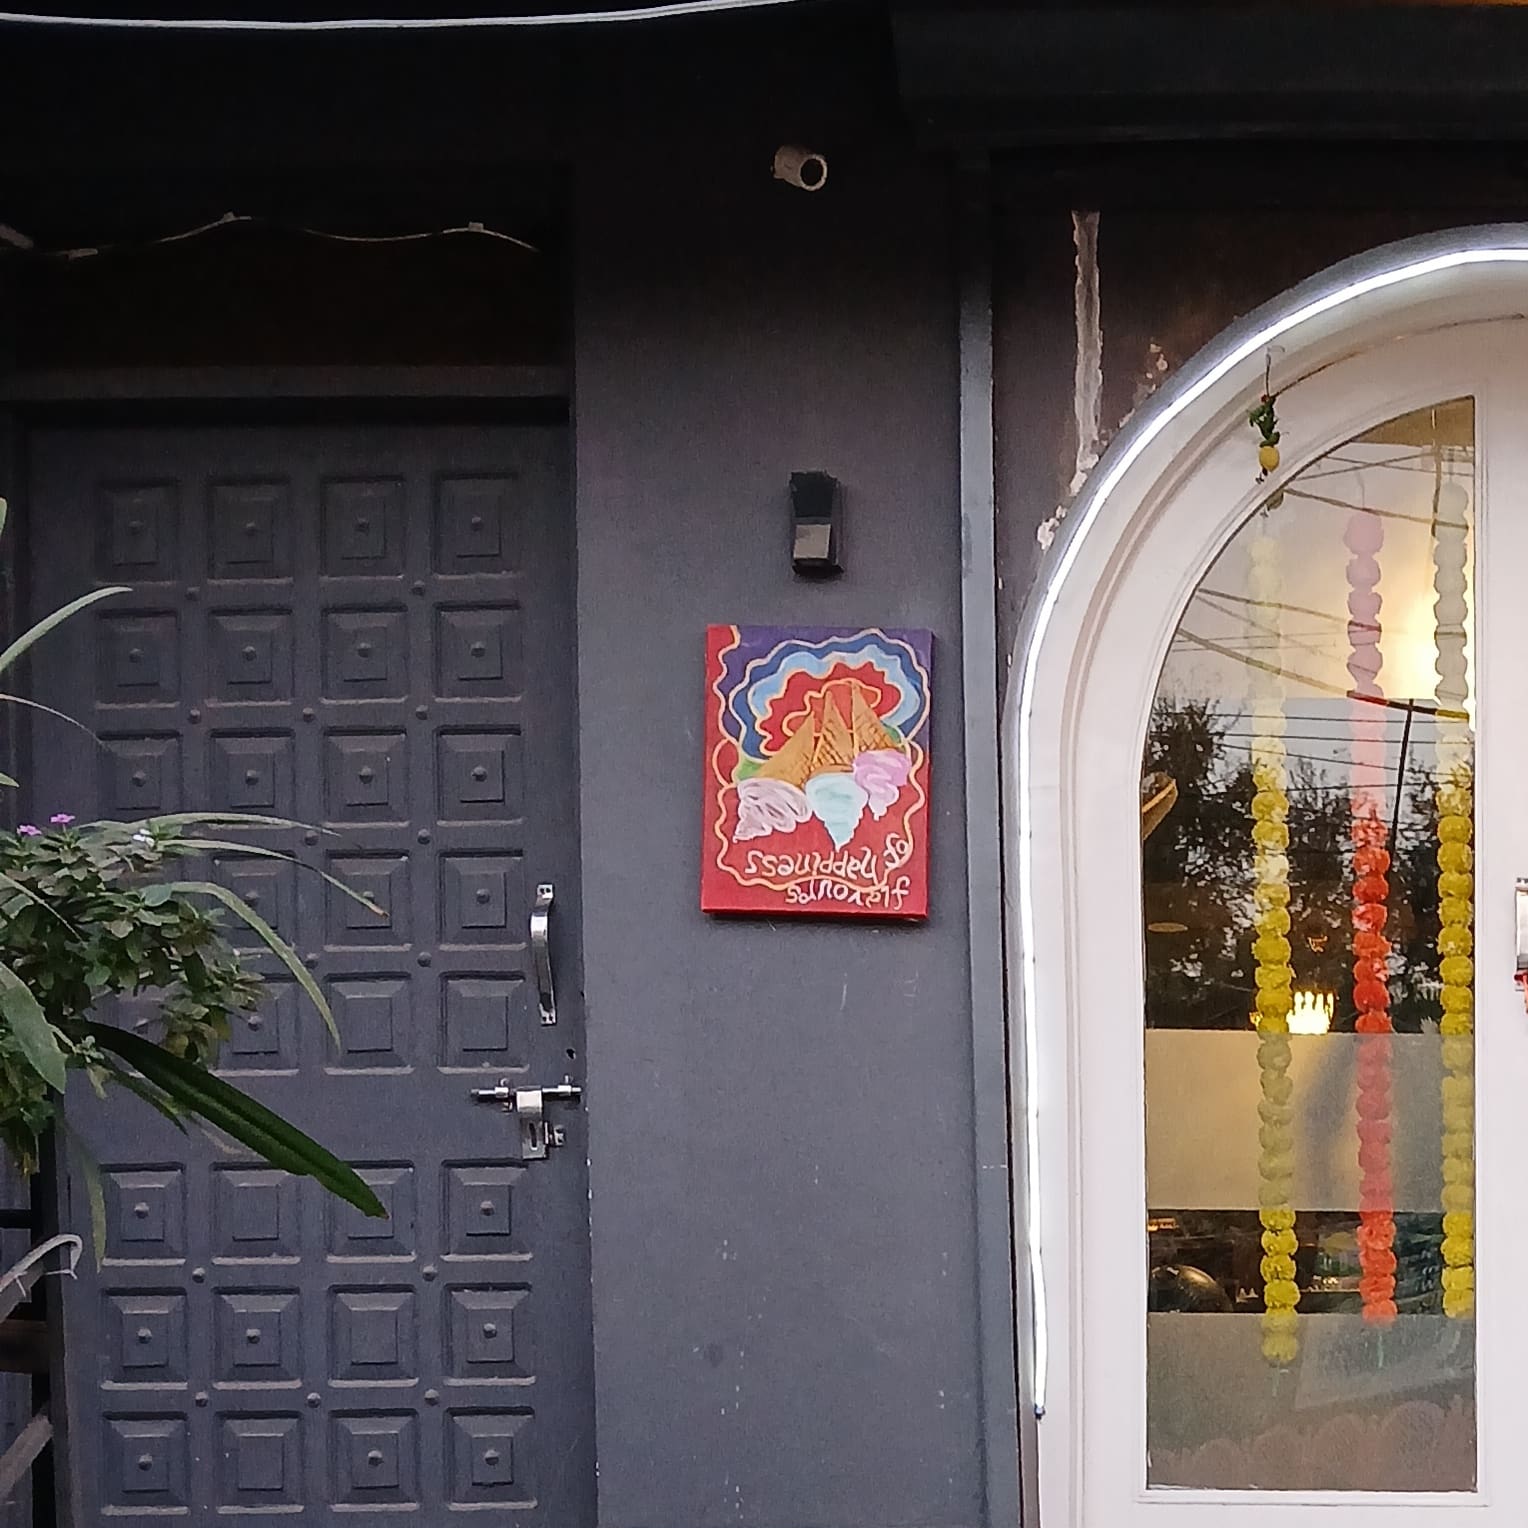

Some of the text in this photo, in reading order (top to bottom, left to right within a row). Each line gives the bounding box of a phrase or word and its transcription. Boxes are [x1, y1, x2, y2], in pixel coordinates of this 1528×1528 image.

[745, 832, 911, 886] of happiness
[785, 876, 911, 911] flavours
